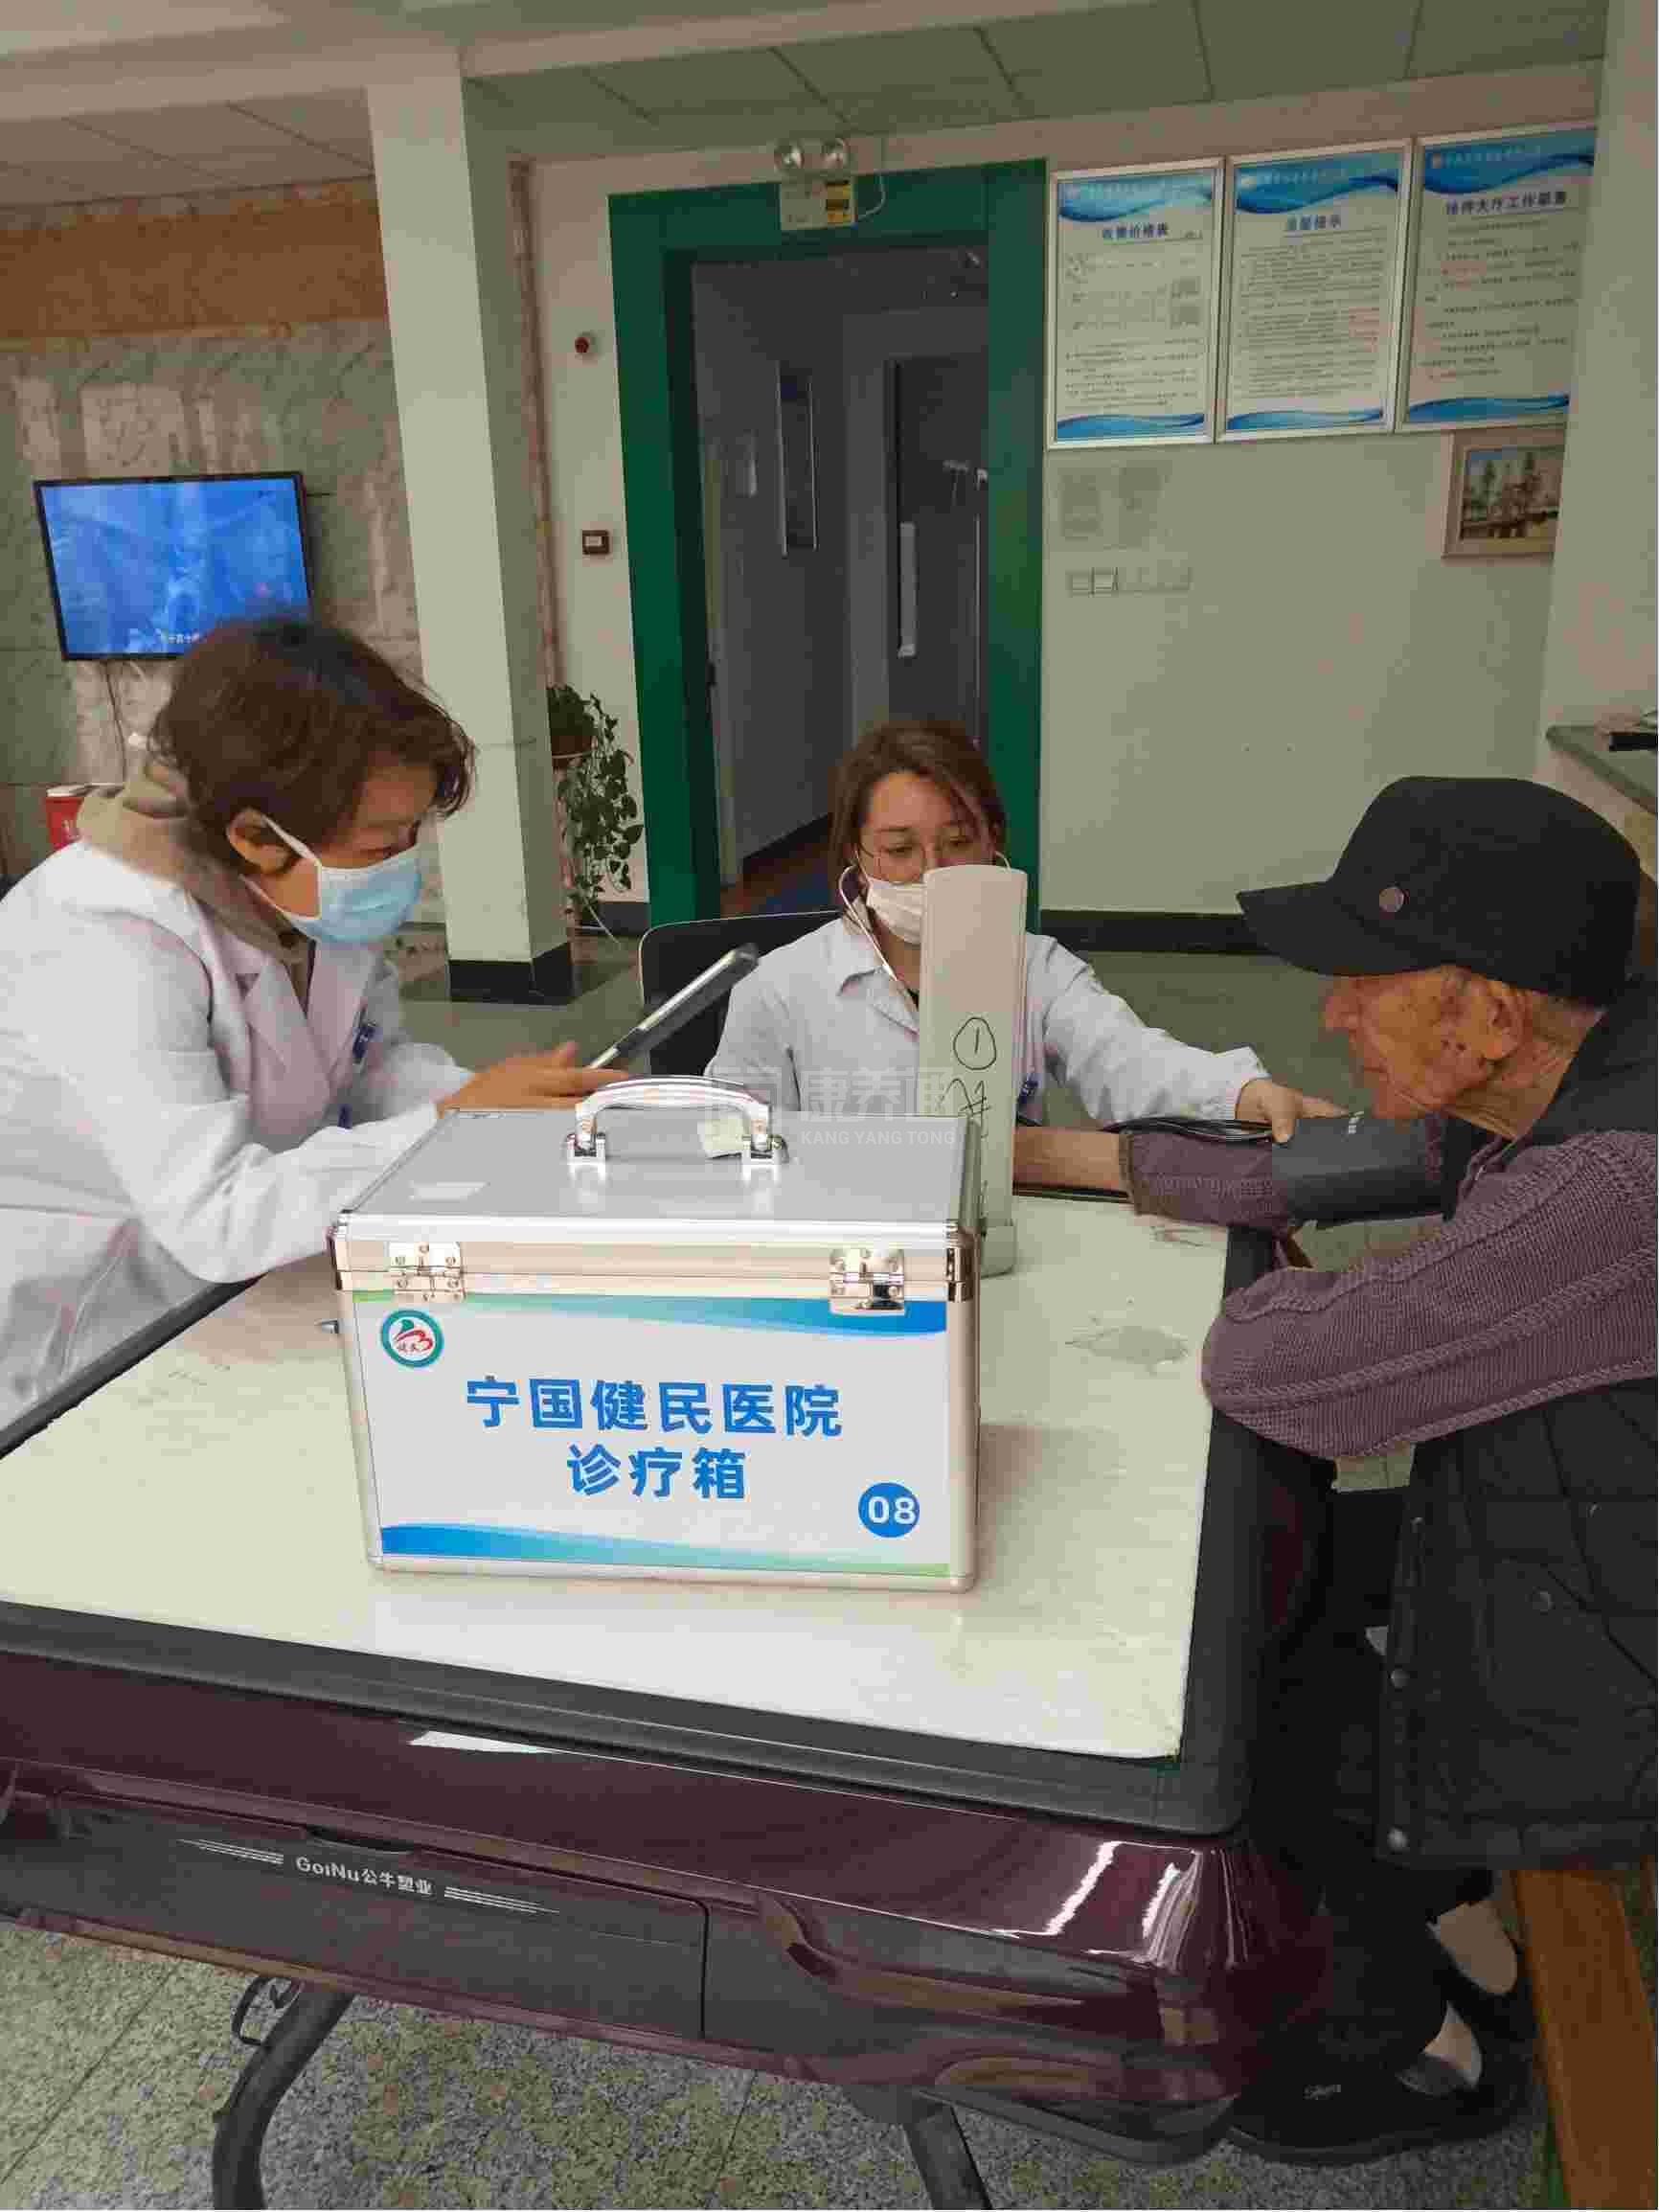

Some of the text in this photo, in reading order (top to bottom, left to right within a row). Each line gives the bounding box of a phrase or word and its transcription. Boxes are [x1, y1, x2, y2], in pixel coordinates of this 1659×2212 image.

[466, 1375, 842, 1437] 宁国健民医院
[567, 1444, 746, 1499] 诊疗箱
[868, 1495, 917, 1524] 08
